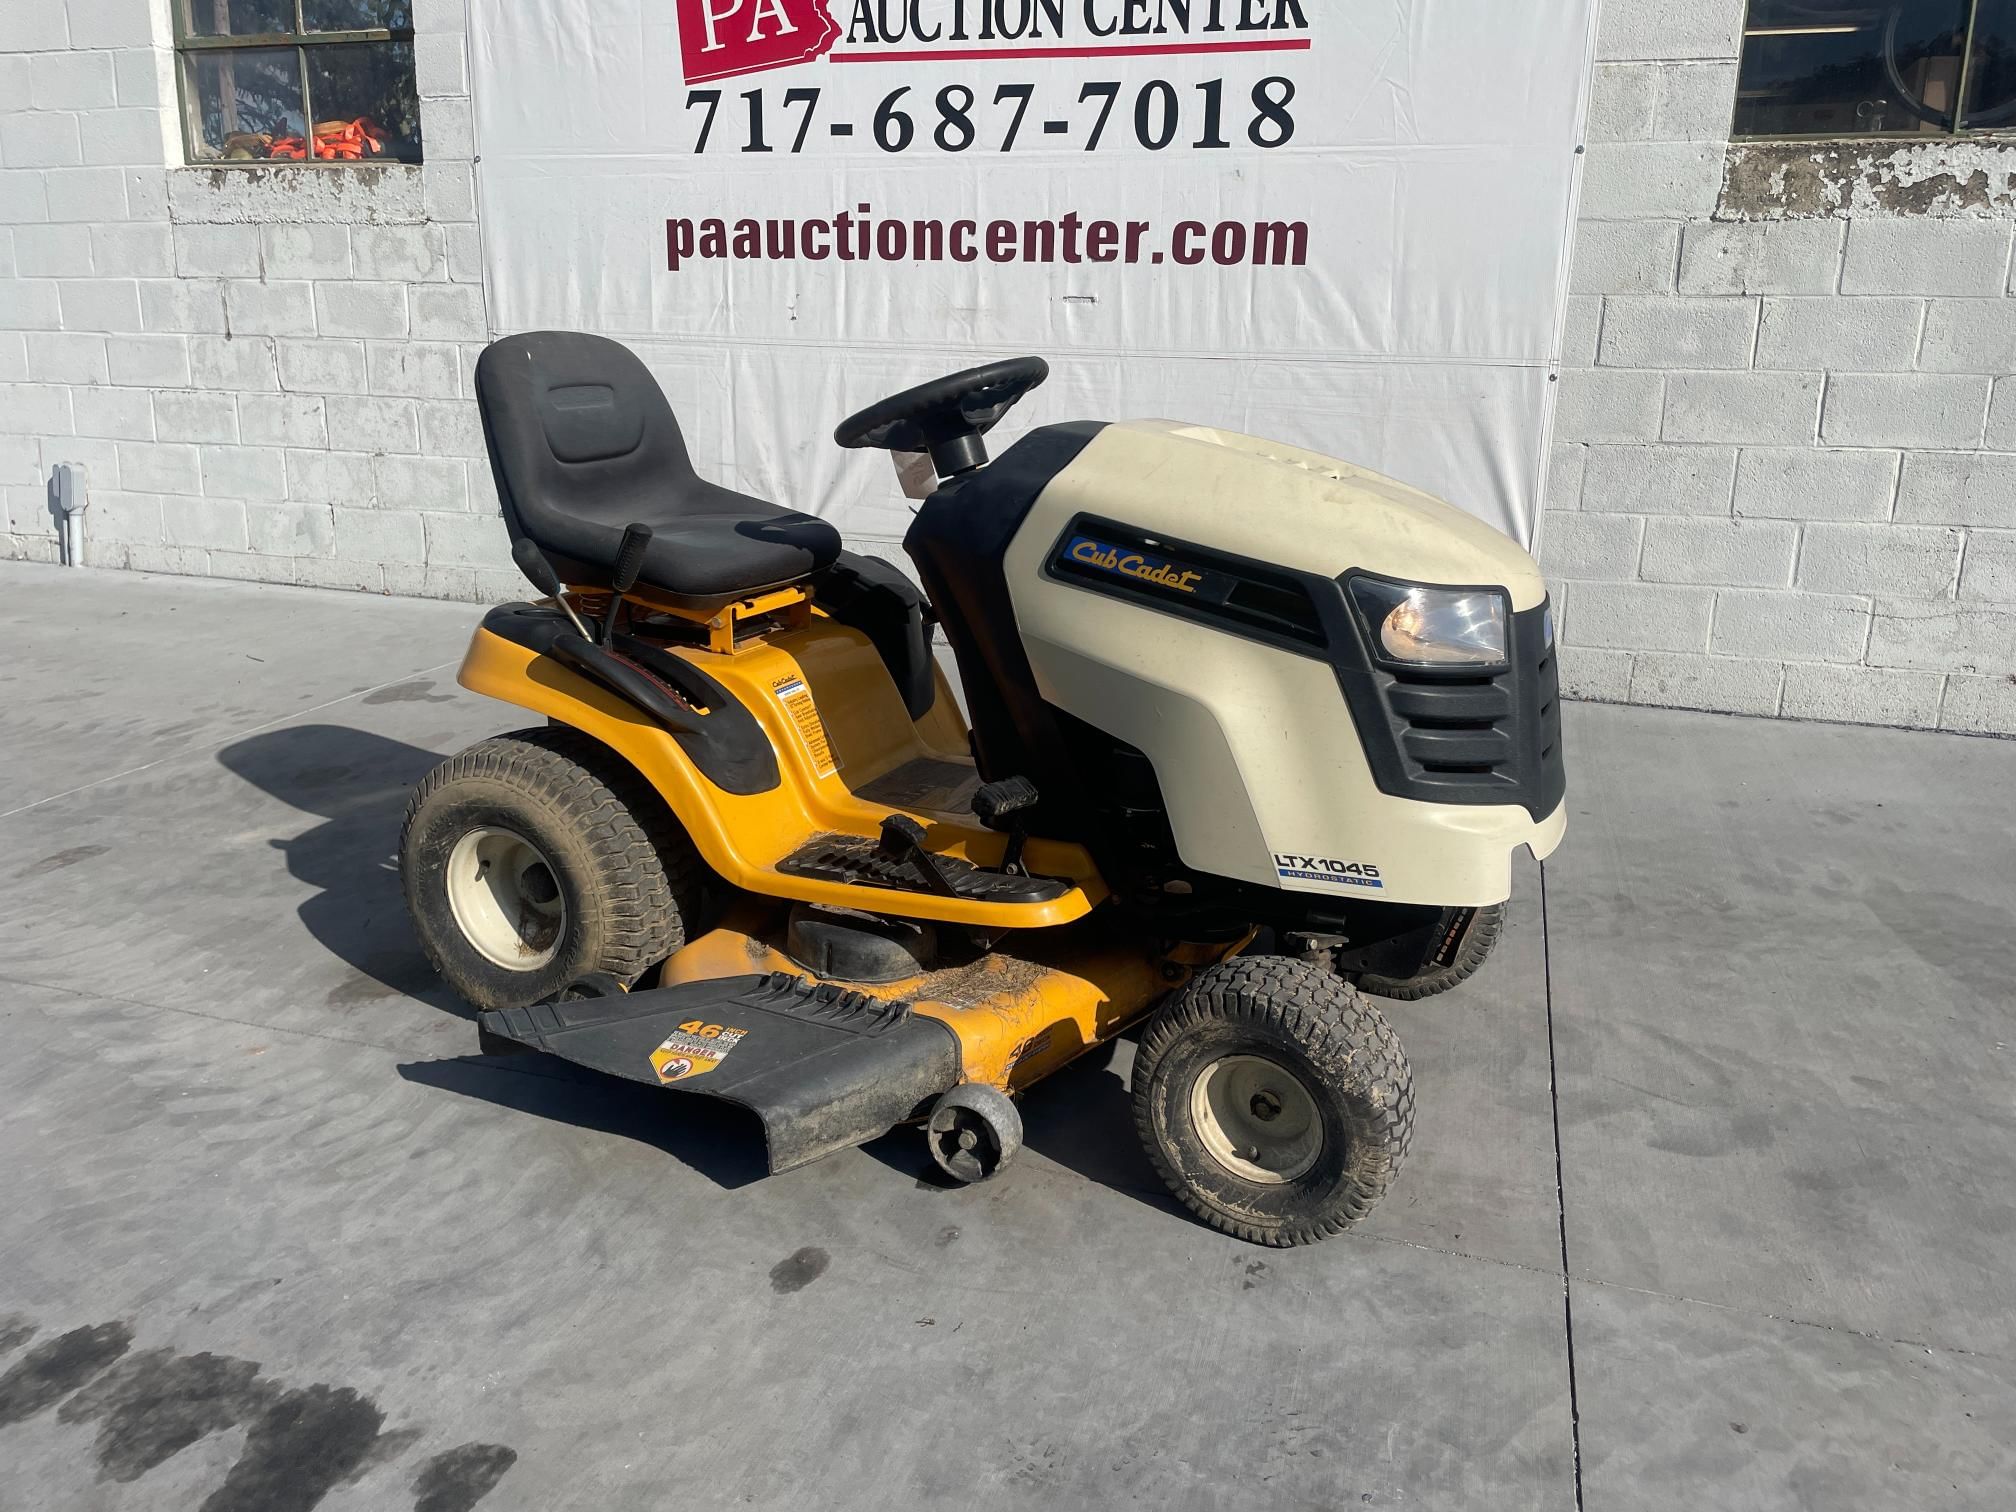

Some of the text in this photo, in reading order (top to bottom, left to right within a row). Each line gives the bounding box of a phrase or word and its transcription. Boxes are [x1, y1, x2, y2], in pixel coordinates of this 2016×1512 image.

[697, 0, 1309, 52] PA AUCTION CENTER
[684, 76, 1296, 154] 717-687-7018
[666, 203, 1310, 271] paauctioncenter.com
[1287, 870, 1375, 886] HYDROSTATIC
[678, 1020, 724, 1038] 46
[670, 1043, 717, 1058] DANGER
